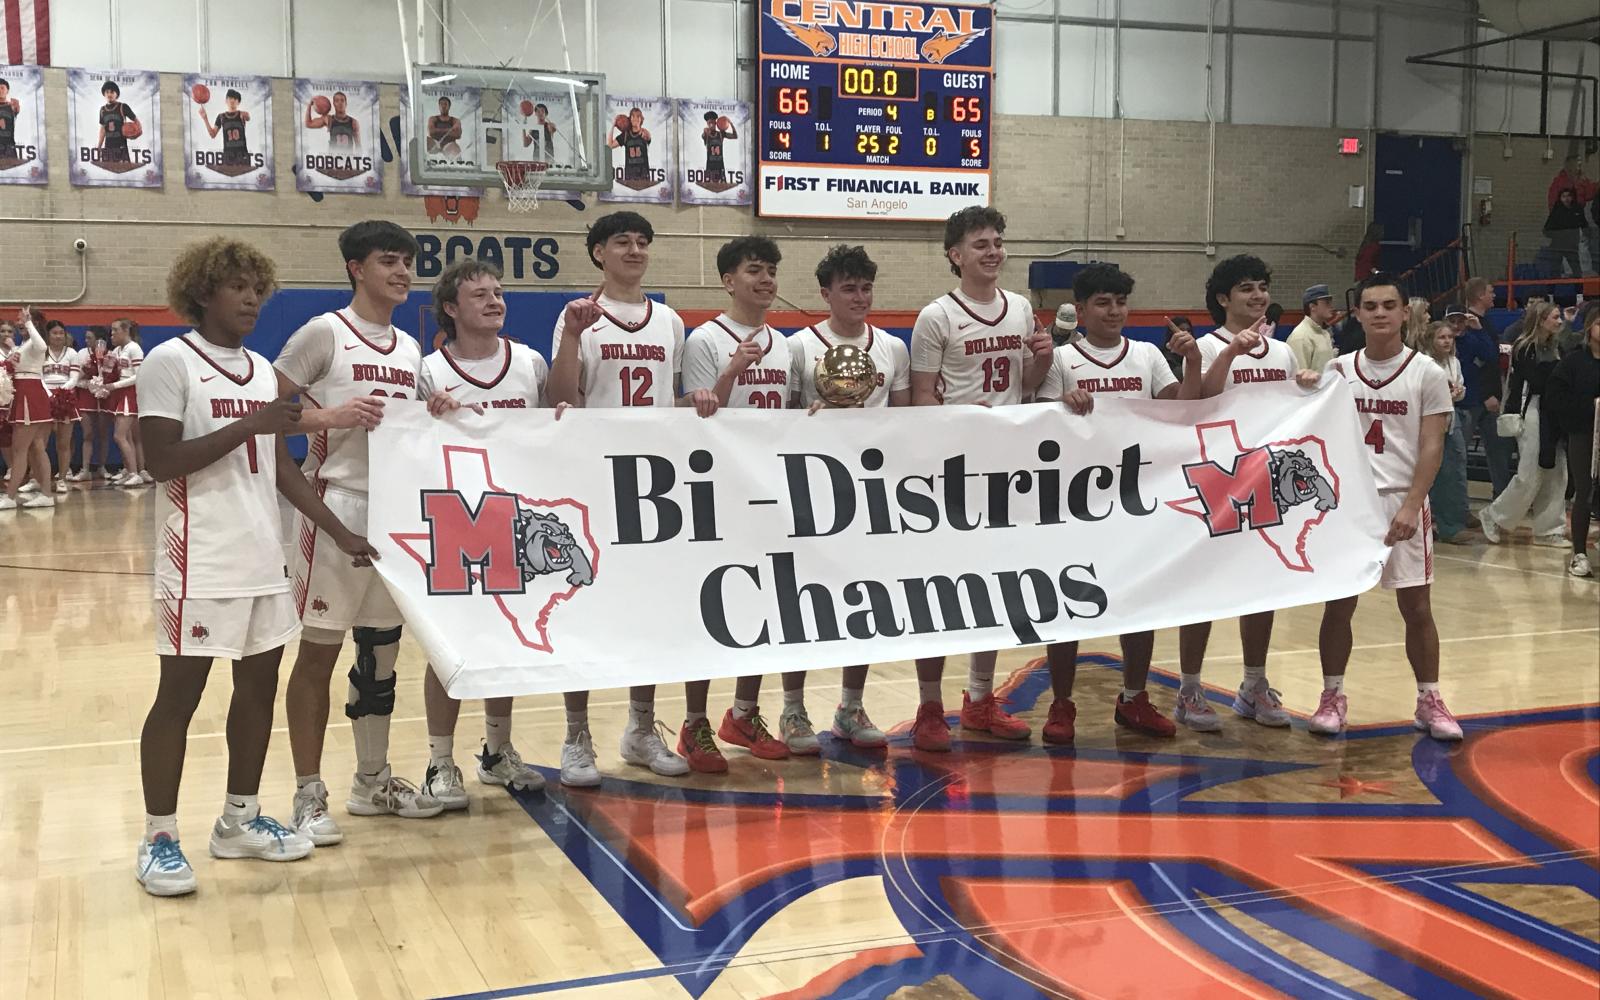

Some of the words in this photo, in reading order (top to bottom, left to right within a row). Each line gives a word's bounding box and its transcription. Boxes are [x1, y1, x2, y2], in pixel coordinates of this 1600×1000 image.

[770, 0, 988, 35] CENTRAL
[838, 32, 870, 57] HIGH
[871, 35, 920, 60] SCHOOL
[770, 62, 810, 81] HOME
[943, 73, 985, 89] GUEST
[779, 88, 809, 114] 66
[953, 98, 981, 122] 65
[858, 107, 883, 117] PERIOD
[886, 105, 897, 120] 4
[769, 121, 791, 130] FOULS
[815, 122, 833, 131] T.O.L.
[856, 125, 881, 134] PLAYER
[886, 126, 903, 135] FOUL
[923, 127, 940, 136] T.O.L.
[961, 129, 982, 138] FOULS
[779, 133, 790, 148] 4
[823, 135, 829, 150] 1
[857, 135, 880, 153] 25
[888, 136, 899, 154] 2
[926, 138, 936, 156] 0
[971, 139, 980, 157] 5
[80, 146, 152, 165] BOBTS
[195, 150, 264, 168] BOBTS
[306, 154, 372, 172] BOBCATS
[769, 151, 791, 160] SCORE
[866, 155, 889, 164] MATCH
[961, 159, 982, 167] SCORE
[765, 175, 820, 192] FIRST
[826, 178, 923, 195] FINANCIAL
[930, 182, 980, 197] BANK
[847, 197, 867, 209] San
[871, 198, 908, 212] Angelo
[416, 234, 560, 280] BCATS
[600, 343, 666, 363] BULLDOGS
[964, 334, 1022, 356] BULLDOGS
[352, 363, 415, 390] BULLDOGS
[738, 368, 787, 386] BULLDOGS
[981, 356, 1011, 393] 13
[1233, 369, 1287, 384] BULLDOGS
[619, 366, 654, 407] 12
[1076, 376, 1143, 393] BULLDOGS
[1354, 398, 1408, 416] ULLDOGS
[1364, 419, 1385, 454] 4
[603, 449, 724, 545] Bi
[1181, 444, 1284, 538] M
[420, 488, 526, 597] M
[699, 551, 1109, 649] Champs
